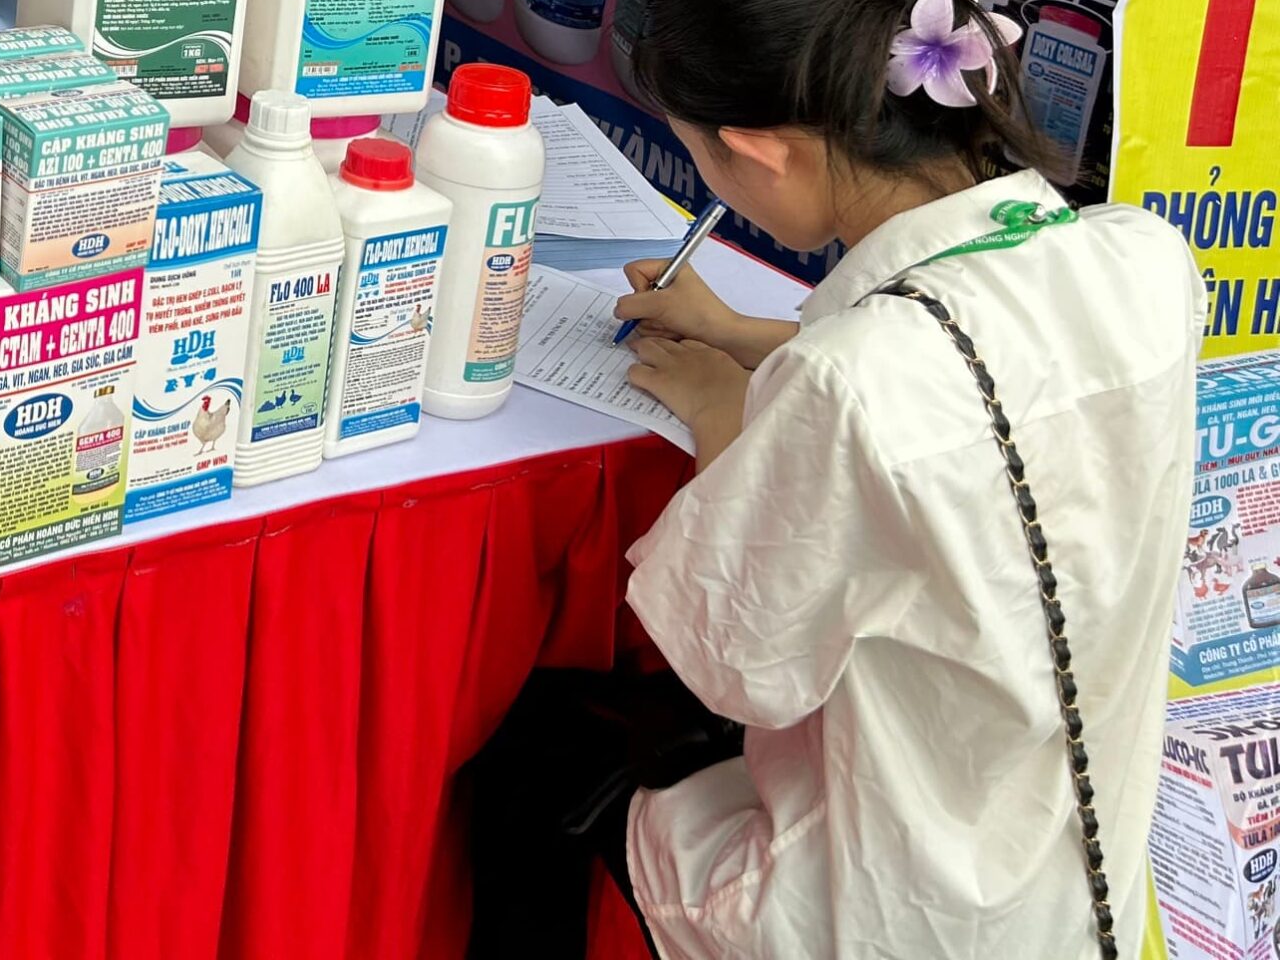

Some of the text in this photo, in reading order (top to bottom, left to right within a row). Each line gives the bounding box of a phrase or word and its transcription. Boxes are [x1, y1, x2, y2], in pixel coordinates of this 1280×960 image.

[76, 128, 125, 150] KHÁNG
[130, 123, 164, 140] SINH
[63, 153, 84, 172] 100
[99, 144, 138, 166] GENTA
[141, 139, 163, 159] 400
[78, 236, 105, 251] HDH
[4, 291, 79, 325] KHÁNG
[85, 278, 136, 314] SINH
[270, 273, 330, 303] FLO 400 LA
[60, 317, 105, 357] GENTA
[108, 310, 134, 345] 400
[173, 329, 216, 355] HDH
[16, 396, 62, 427] HDH
[1214, 468, 1255, 490] 1000 LA
